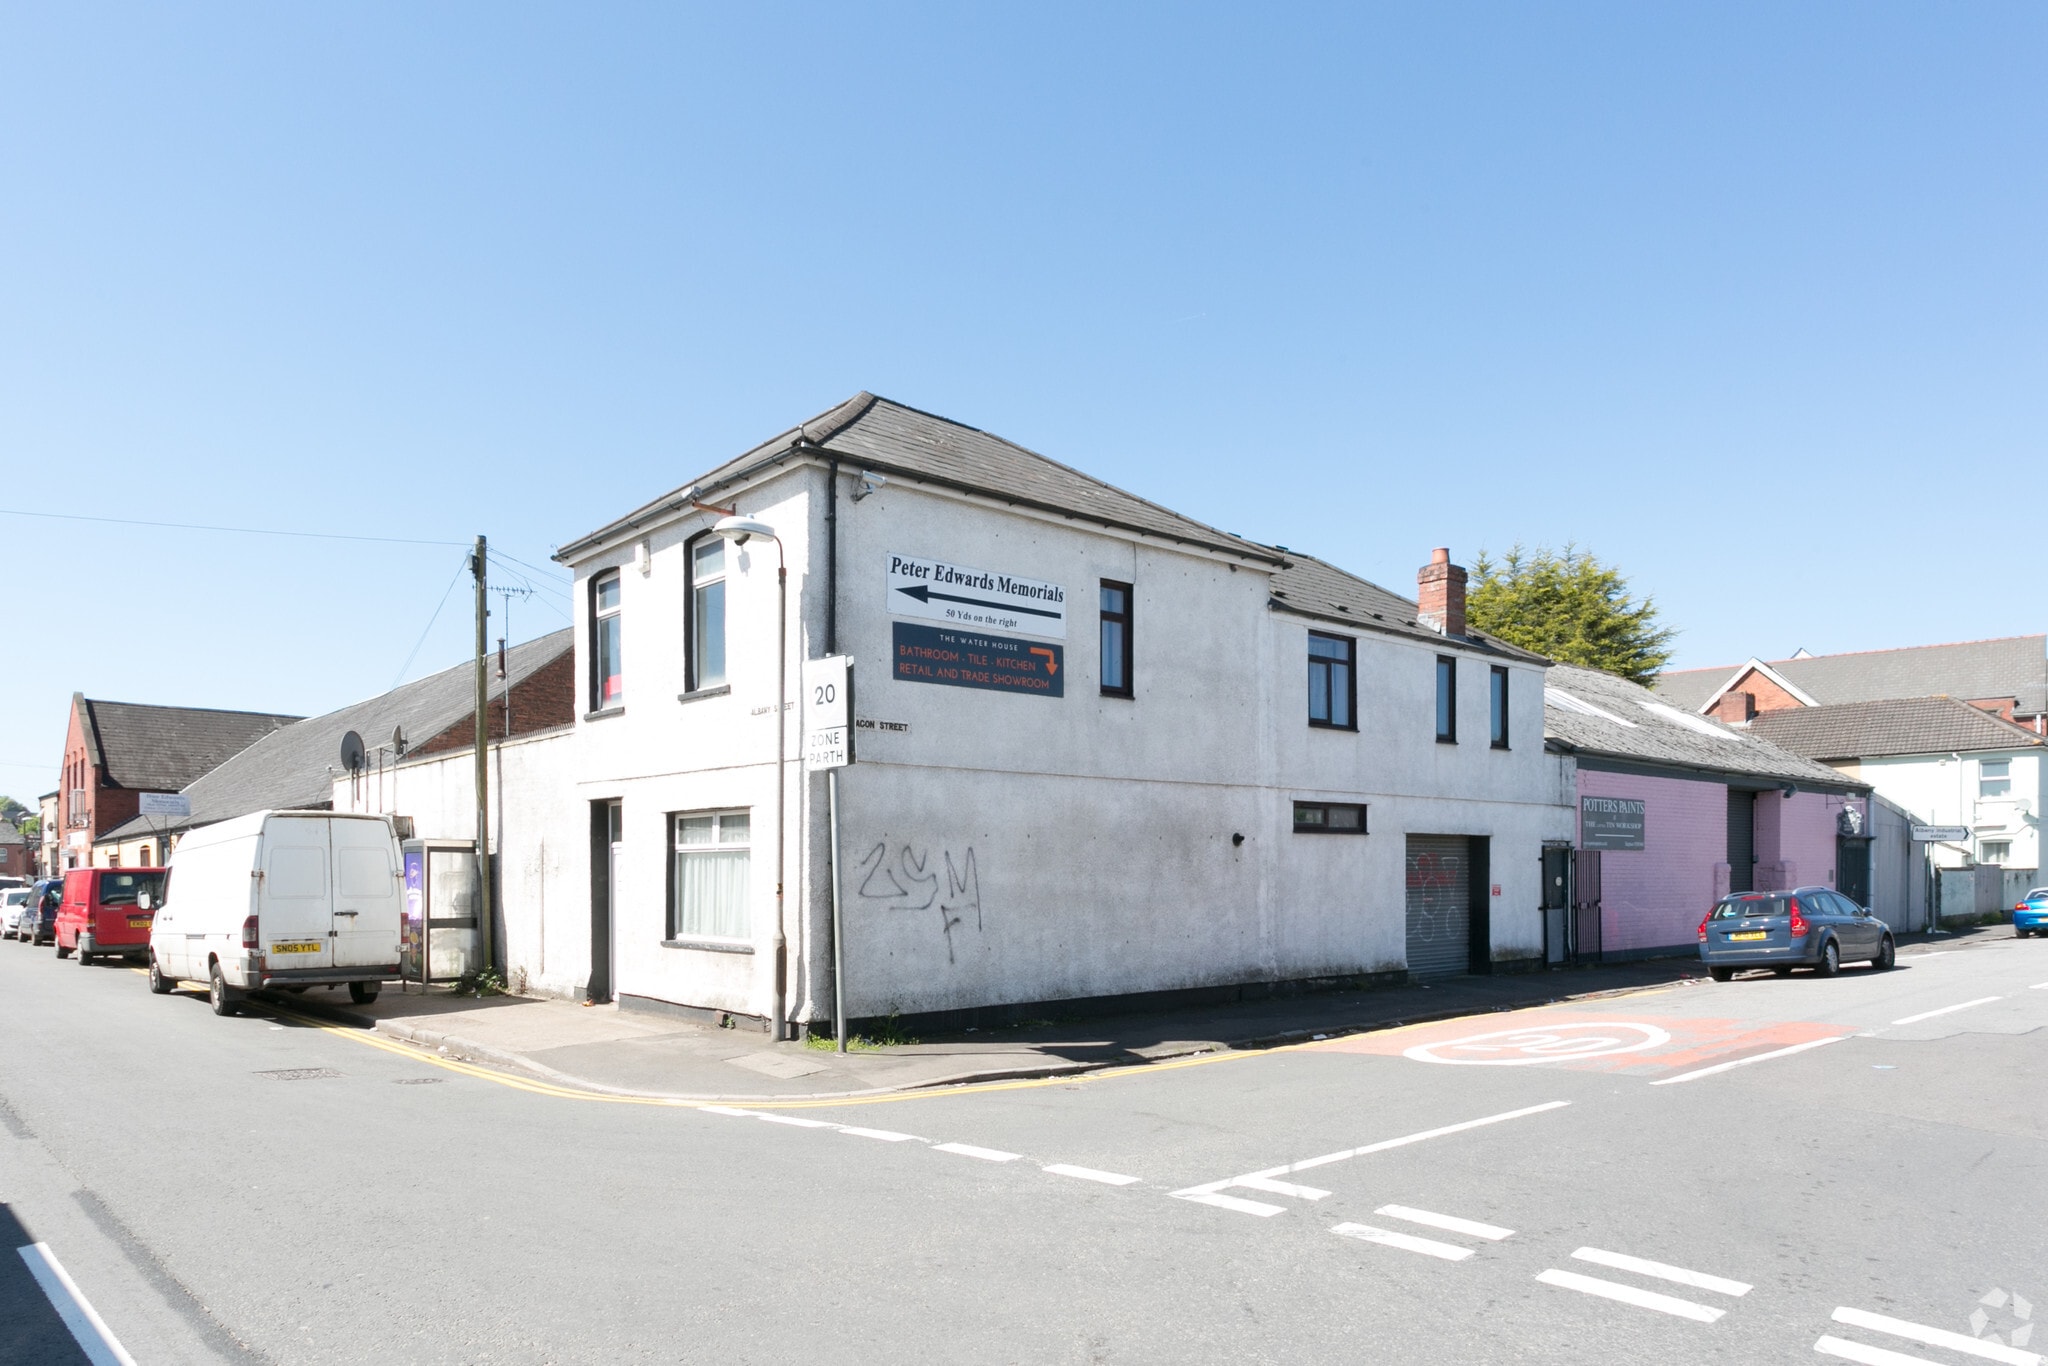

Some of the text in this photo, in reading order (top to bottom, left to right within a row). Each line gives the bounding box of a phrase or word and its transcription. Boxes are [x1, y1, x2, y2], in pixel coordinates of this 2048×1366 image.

[890, 556, 1064, 603] Peter Edwards Memorials
[945, 608, 956, 618] 50
[957, 610, 972, 620] Yds
[985, 616, 997, 624] the
[998, 618, 1018, 628] right
[940, 634, 1019, 651] THE WATER HOUSE
[899, 645, 1036, 672] BATHROOM TILE KITCHEN
[899, 662, 1050, 689] RETAIL AND TRADE SHOWROOM
[815, 683, 836, 705] 20
[774, 701, 795, 712] SEET
[879, 721, 909, 732] STREET
[811, 731, 840, 748] ZONE
[809, 749, 843, 765] PARTH
[1583, 798, 1645, 815] POTTERS PAINTS
[300, 943, 317, 951] YTL
